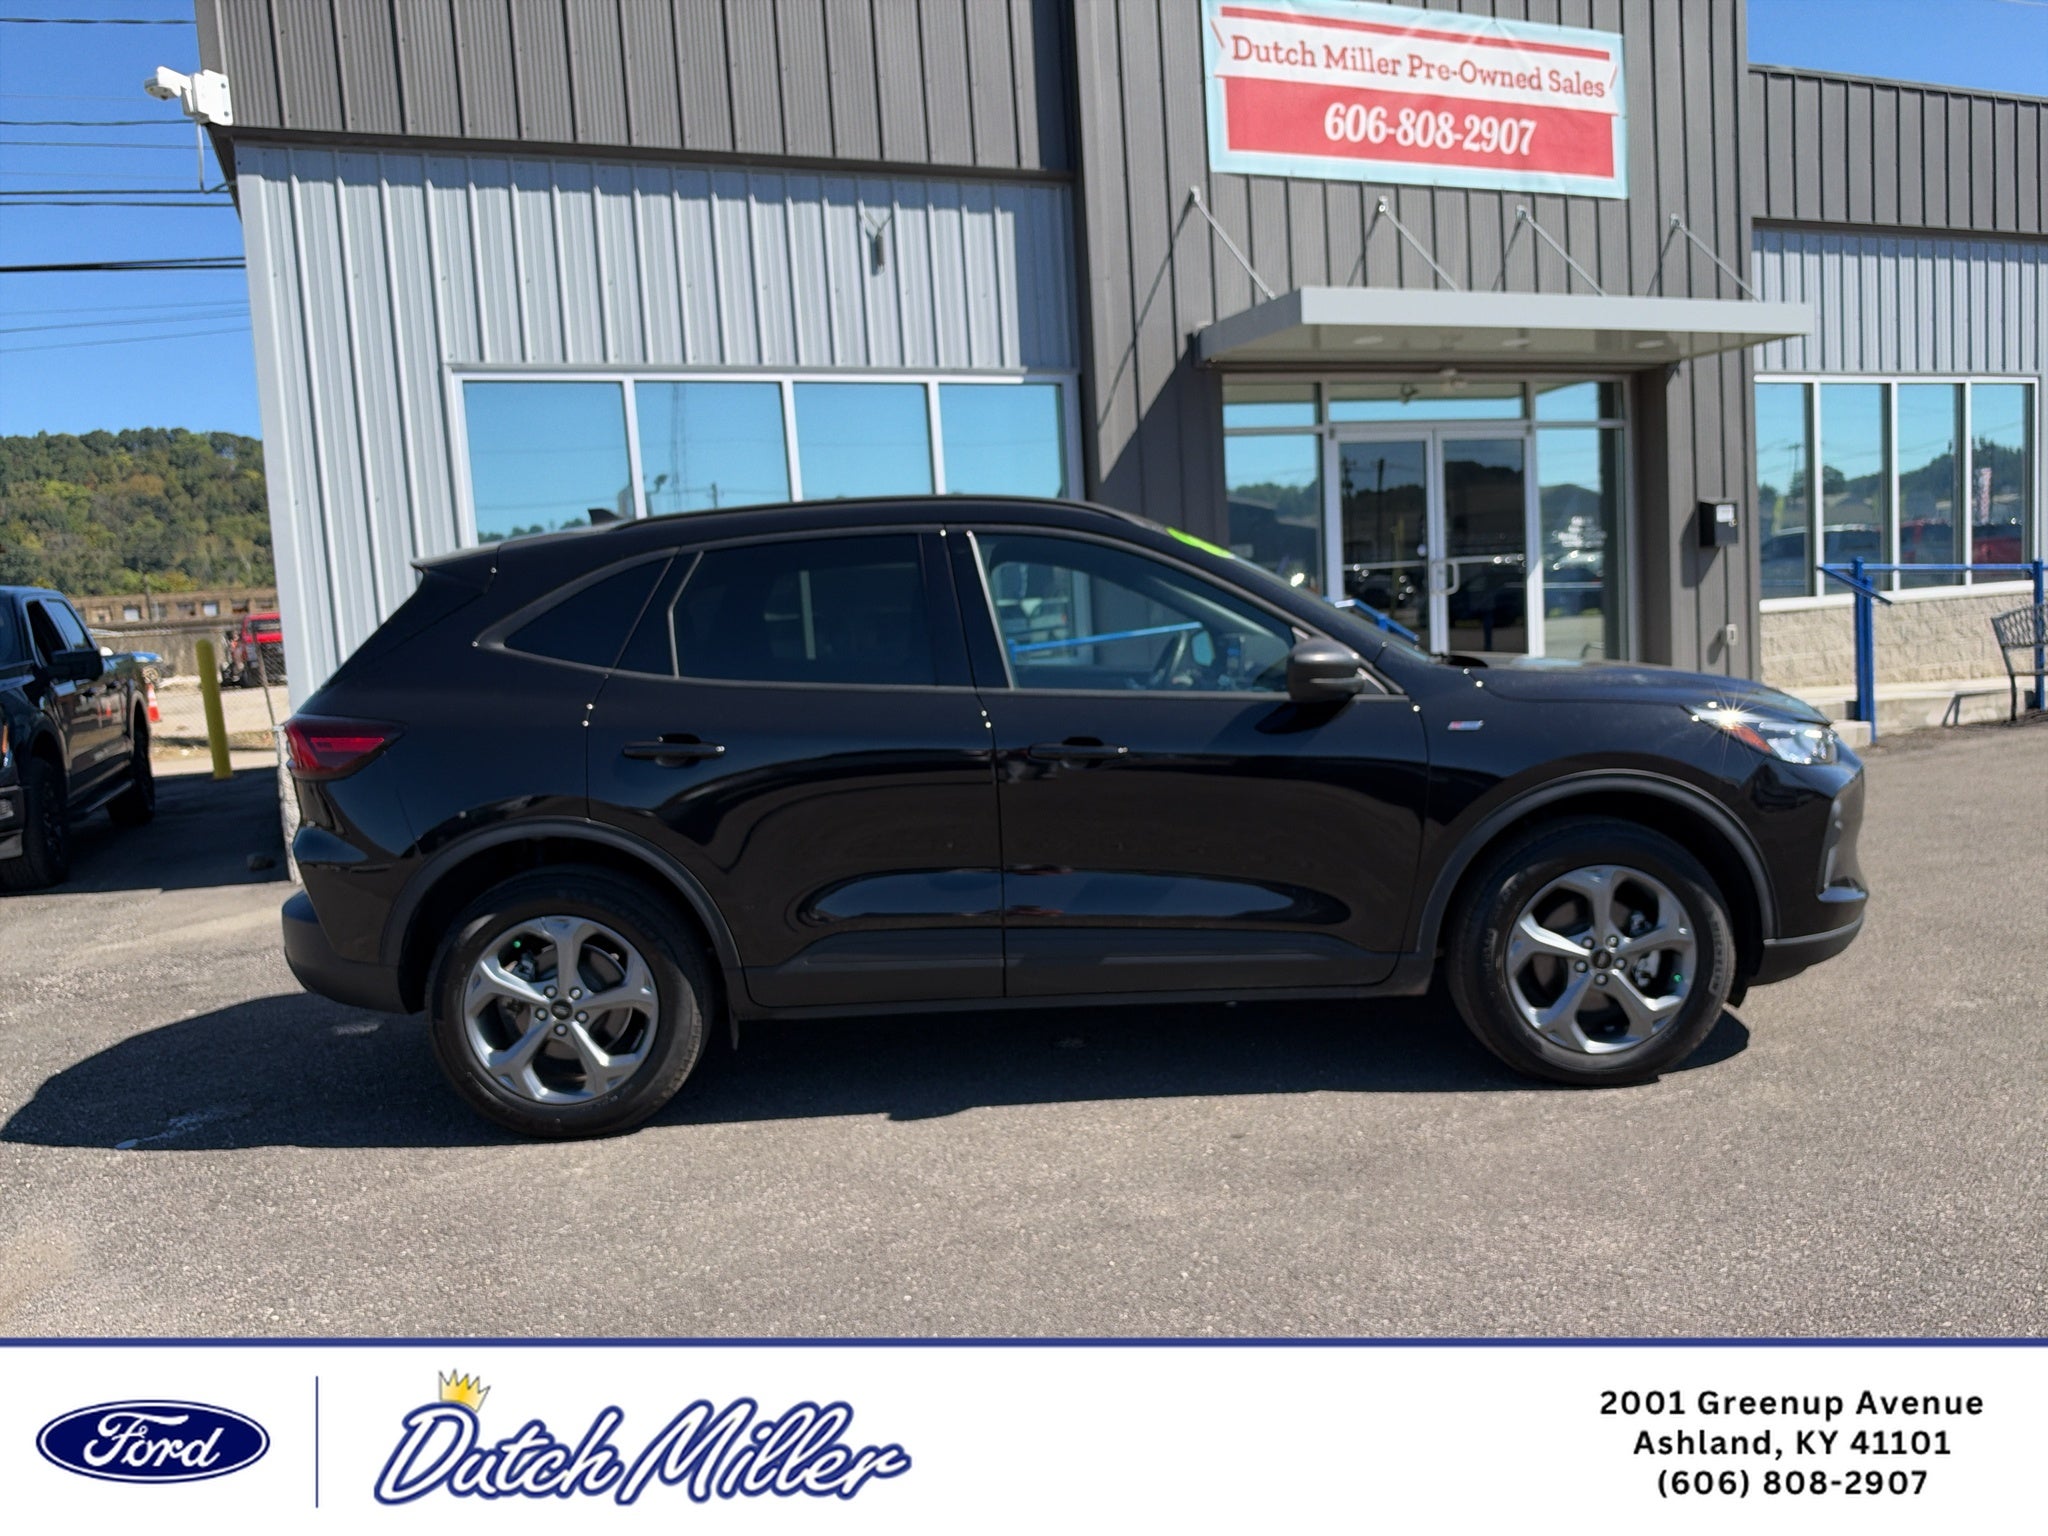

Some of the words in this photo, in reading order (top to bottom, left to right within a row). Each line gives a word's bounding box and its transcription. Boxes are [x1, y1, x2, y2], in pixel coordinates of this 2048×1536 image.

[1231, 34, 1317, 68] Dutch
[1323, 44, 1402, 77] Miller
[1407, 53, 1543, 92] Pre-Owned
[1548, 69, 1606, 98] Sales
[1324, 102, 1537, 156] 606-808-2907
